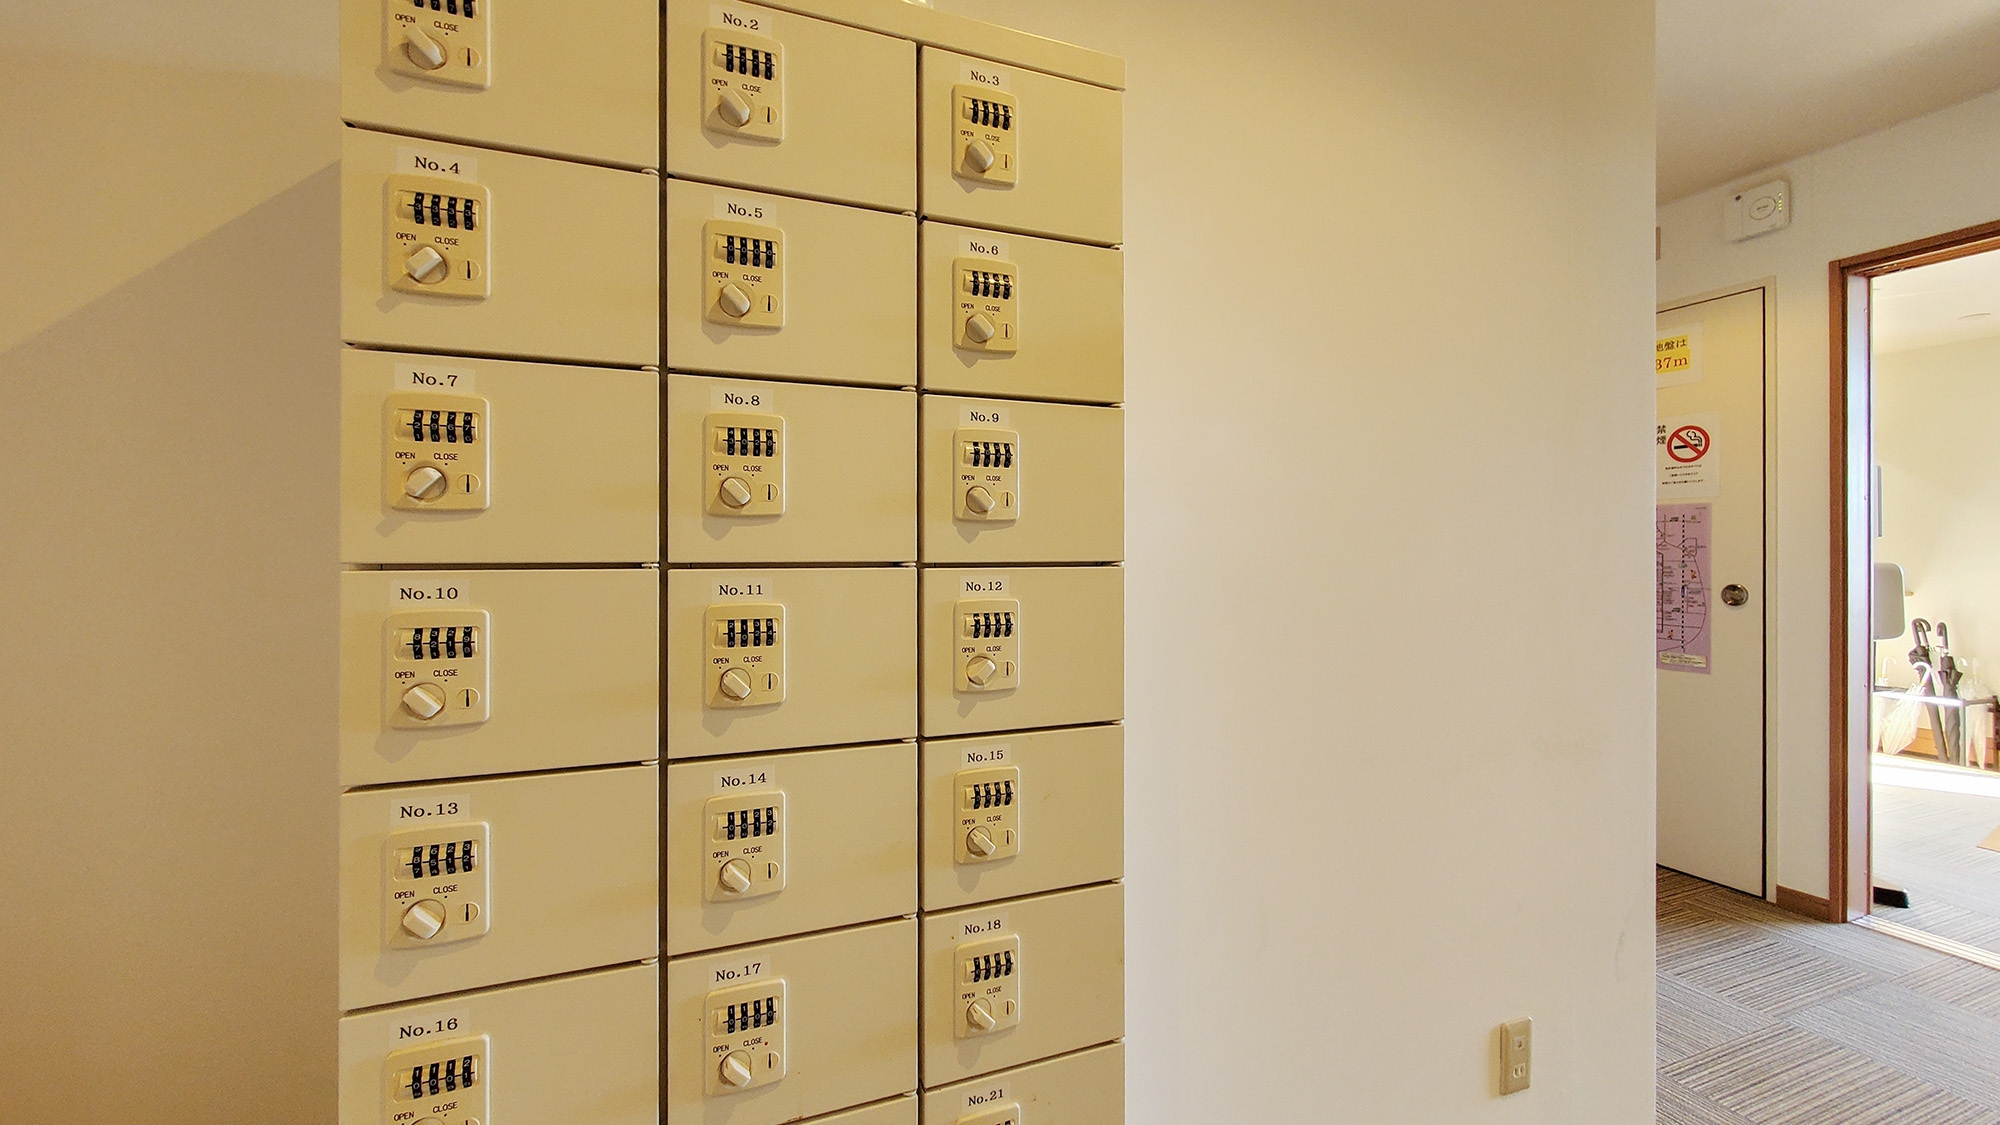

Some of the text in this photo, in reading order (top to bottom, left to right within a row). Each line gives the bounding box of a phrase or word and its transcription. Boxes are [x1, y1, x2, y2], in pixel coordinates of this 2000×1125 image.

[394, 13, 459, 32] OPEN CLOSE
[722, 12, 759, 31] No.2
[711, 78, 762, 93] OPEN CLOSE
[970, 70, 1000, 86] No.3
[960, 129, 1001, 143] OPEN CLOSE
[414, 155, 460, 175] No.4
[727, 202, 763, 219] No.5
[395, 232, 459, 246] OPEN CLOSE
[969, 241, 999, 256] No.6
[712, 271, 763, 282] OPEN CLOSE
[960, 302, 1001, 313] OPEN CLOSE
[412, 371, 458, 387] No.7
[724, 392, 760, 407] No.8
[970, 411, 999, 423] No.9
[394, 451, 459, 461] OPEN CLOSE
[718, 584, 763, 596] No.11
[965, 580, 1003, 592] No.12
[399, 587, 459, 601] No.10
[712, 655, 763, 665] OPEN CLOSE
[394, 668, 458, 679] OPEN CLOSE
[967, 749, 1004, 763] No.15
[720, 772, 767, 788] No.14
[400, 802, 459, 819] No.13
[961, 814, 1002, 826] OPEN CLOSE
[712, 845, 763, 858] OPEN CLOSE
[394, 884, 458, 900] OPEN CLOSE
[964, 919, 1002, 935] No.18
[715, 962, 762, 983] No.17
[961, 985, 1002, 1000] OPEN CLOSE
[399, 1017, 458, 1040] No.16
[712, 1036, 763, 1053] OPEN CLOSE
[968, 1088, 1003, 1107] No.21
[393, 1101, 458, 1121] OPEN CLOSE
